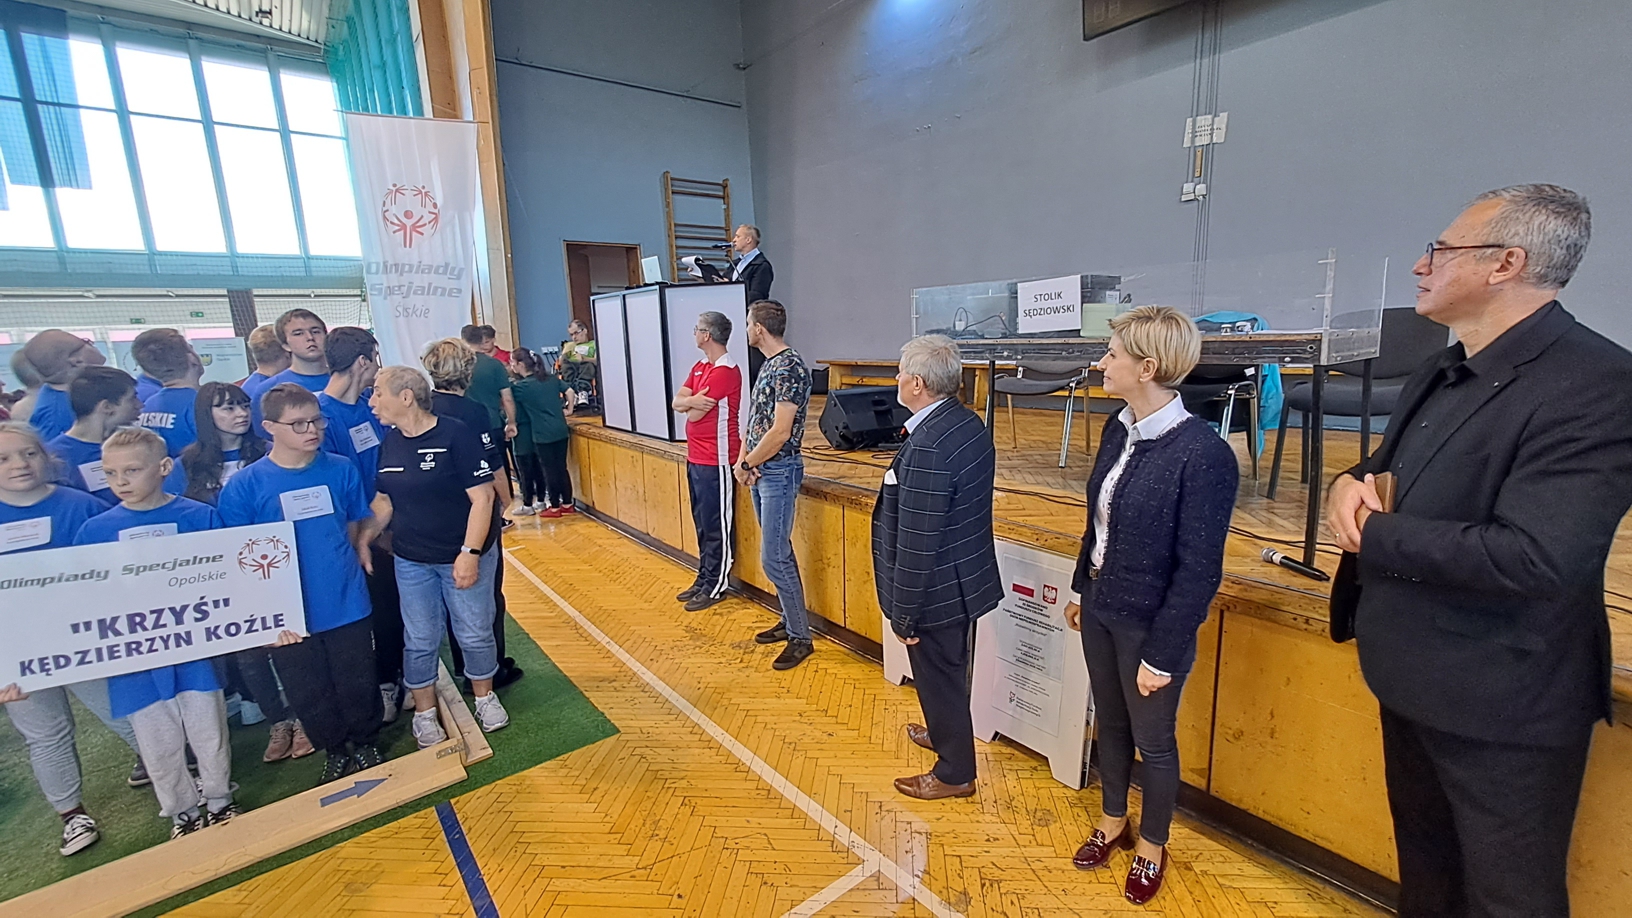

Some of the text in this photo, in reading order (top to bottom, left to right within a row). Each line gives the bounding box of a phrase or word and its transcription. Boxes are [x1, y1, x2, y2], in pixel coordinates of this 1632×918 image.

[1033, 291, 1063, 302] STOLIK
[395, 302, 431, 318] Ślskie
[1023, 304, 1075, 318] SĘDZIOWSKI
[0, 554, 224, 591] Olimpiady Specjalne
[168, 570, 227, 588] Opolskie
[70, 595, 231, 640] "KRZYŚ"
[19, 613, 285, 677] KĘDZIERZYN KOŹLE
